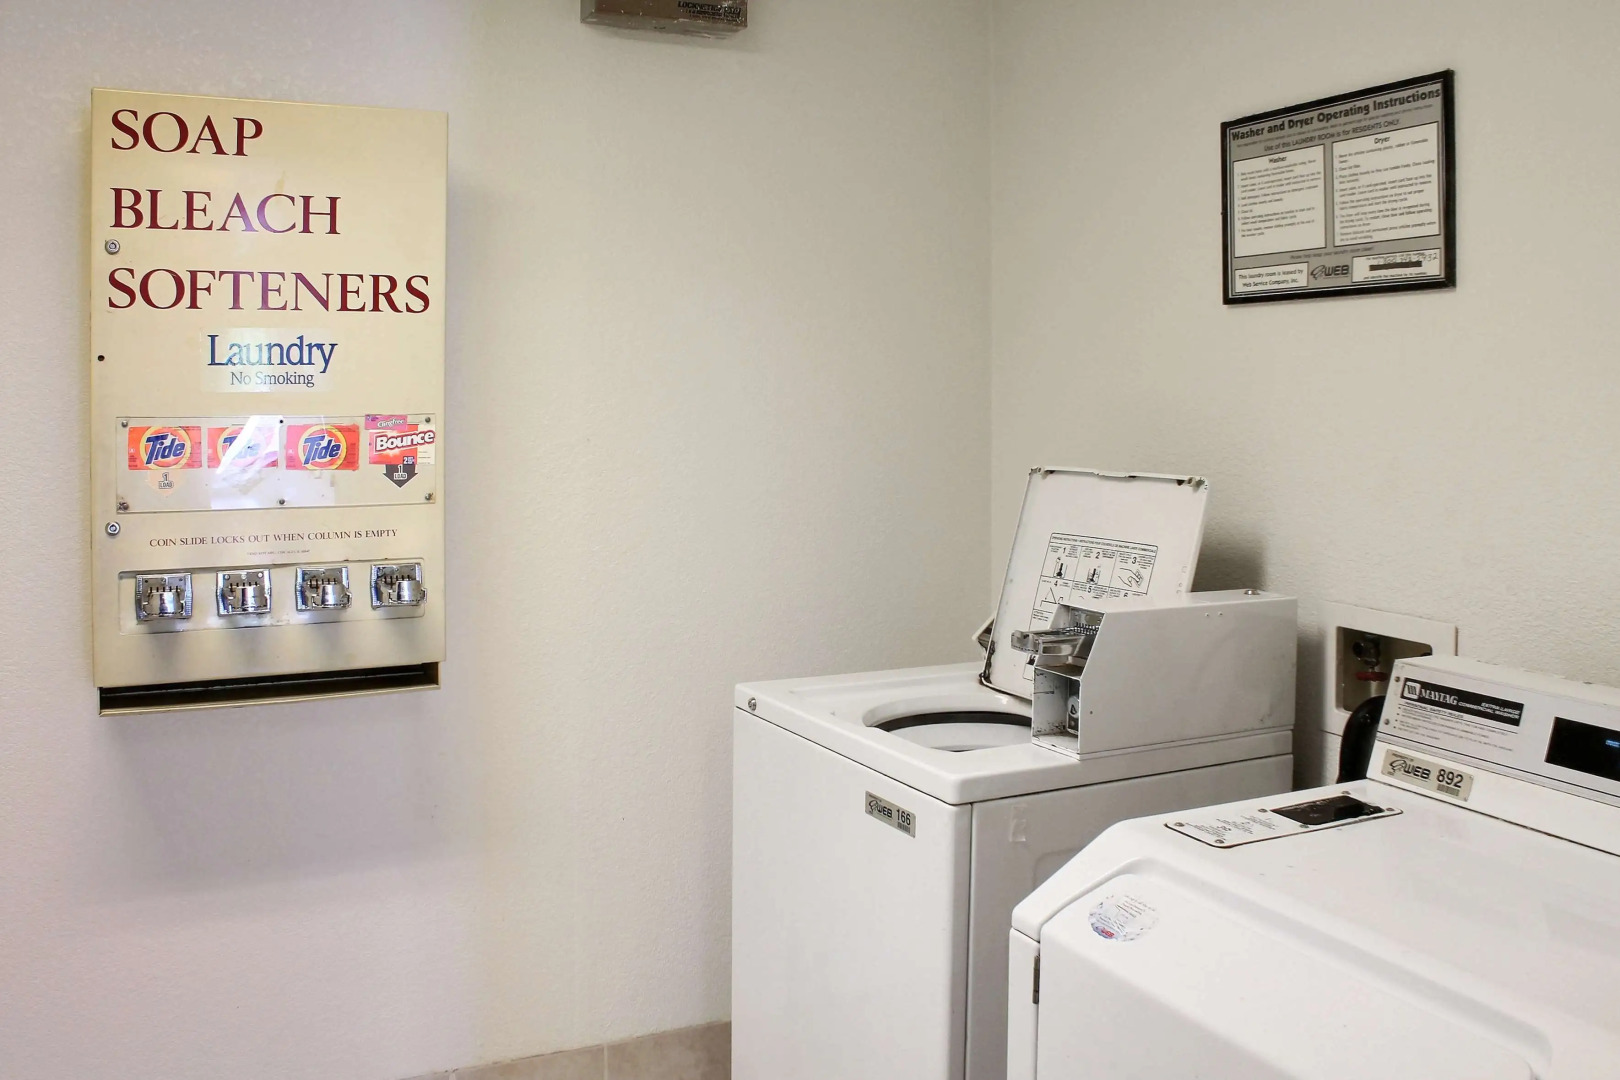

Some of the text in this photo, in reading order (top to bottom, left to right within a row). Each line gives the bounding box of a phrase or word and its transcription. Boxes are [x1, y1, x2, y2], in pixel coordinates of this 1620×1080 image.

[1231, 128, 1265, 141] Washer
[1267, 121, 1285, 134] and
[1288, 115, 1314, 130] Dryer
[1317, 104, 1370, 123] Operating
[1373, 88, 1441, 111] Instructions
[111, 108, 263, 157] SOAP
[1292, 135, 1316, 146] LAUNDRY
[1342, 128, 1351, 136] for
[1352, 121, 1382, 133] RESIDENTS
[1374, 136, 1390, 145] Dryer
[1268, 156, 1287, 164] Washer
[109, 187, 341, 235] BLEACH
[1324, 264, 1349, 277] WEB
[107, 267, 430, 314] SOFTENERS
[207, 334, 338, 374] Laundry
[230, 371, 315, 388] No Smoking
[145, 433, 186, 465] Tide
[302, 433, 341, 466] Tide
[375, 430, 435, 451] Bounce
[149, 529, 397, 547] COIN SLIDE LOCKS OUT WHEN COLUMN IS EMPTY
[1131, 556, 1137, 564] 3
[1420, 688, 1459, 706] MAYTAG
[1403, 763, 1464, 788] WEB 892
[877, 803, 911, 826] WEB 166
